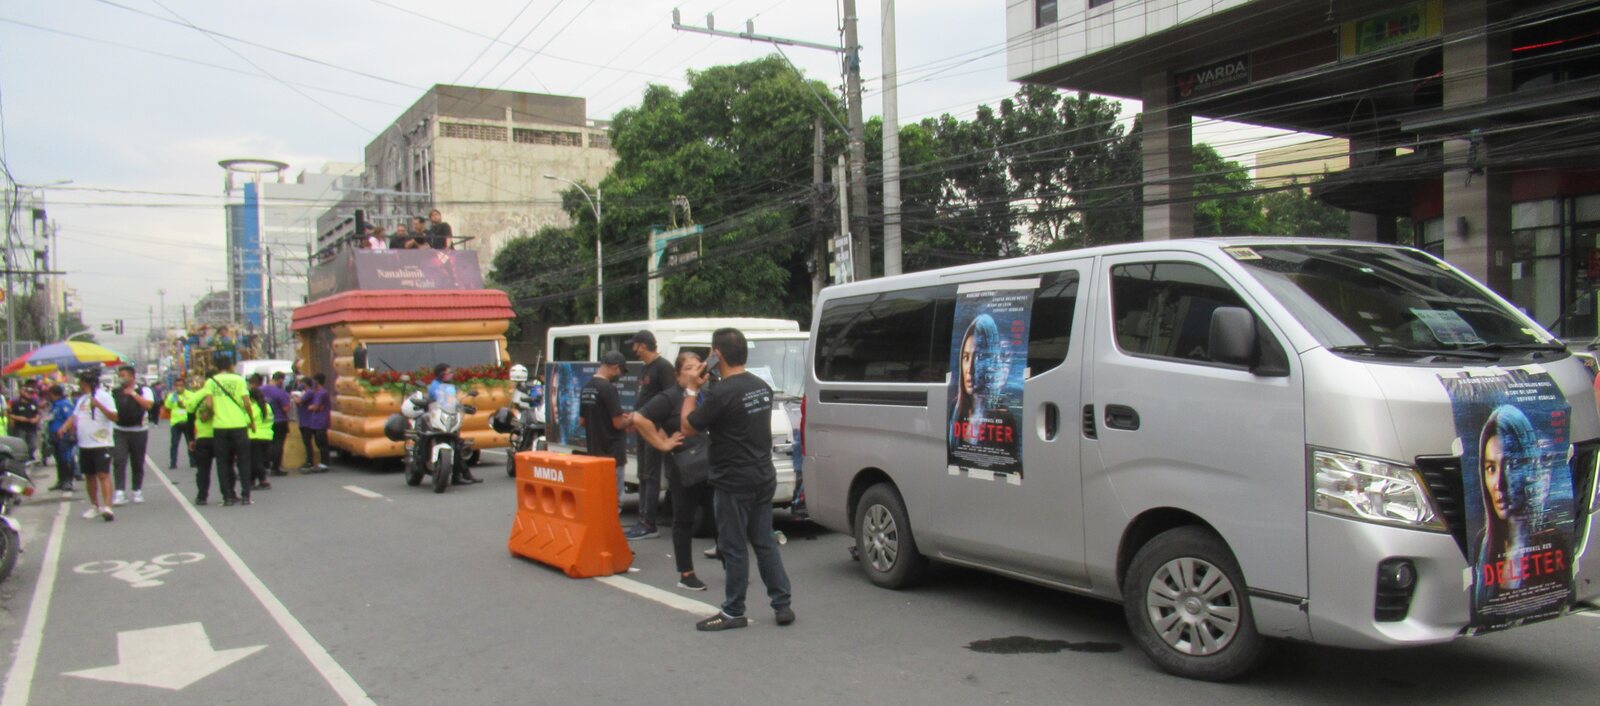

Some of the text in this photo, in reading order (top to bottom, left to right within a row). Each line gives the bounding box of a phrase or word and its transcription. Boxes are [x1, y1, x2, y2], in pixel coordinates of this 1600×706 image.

[1196, 60, 1246, 84] VARDA
[376, 268, 425, 278] Nanahimik
[415, 279, 436, 288] Gabi
[954, 421, 1013, 442] DELETER
[533, 466, 565, 483] MMDA
[1482, 549, 1565, 587] DELETER
